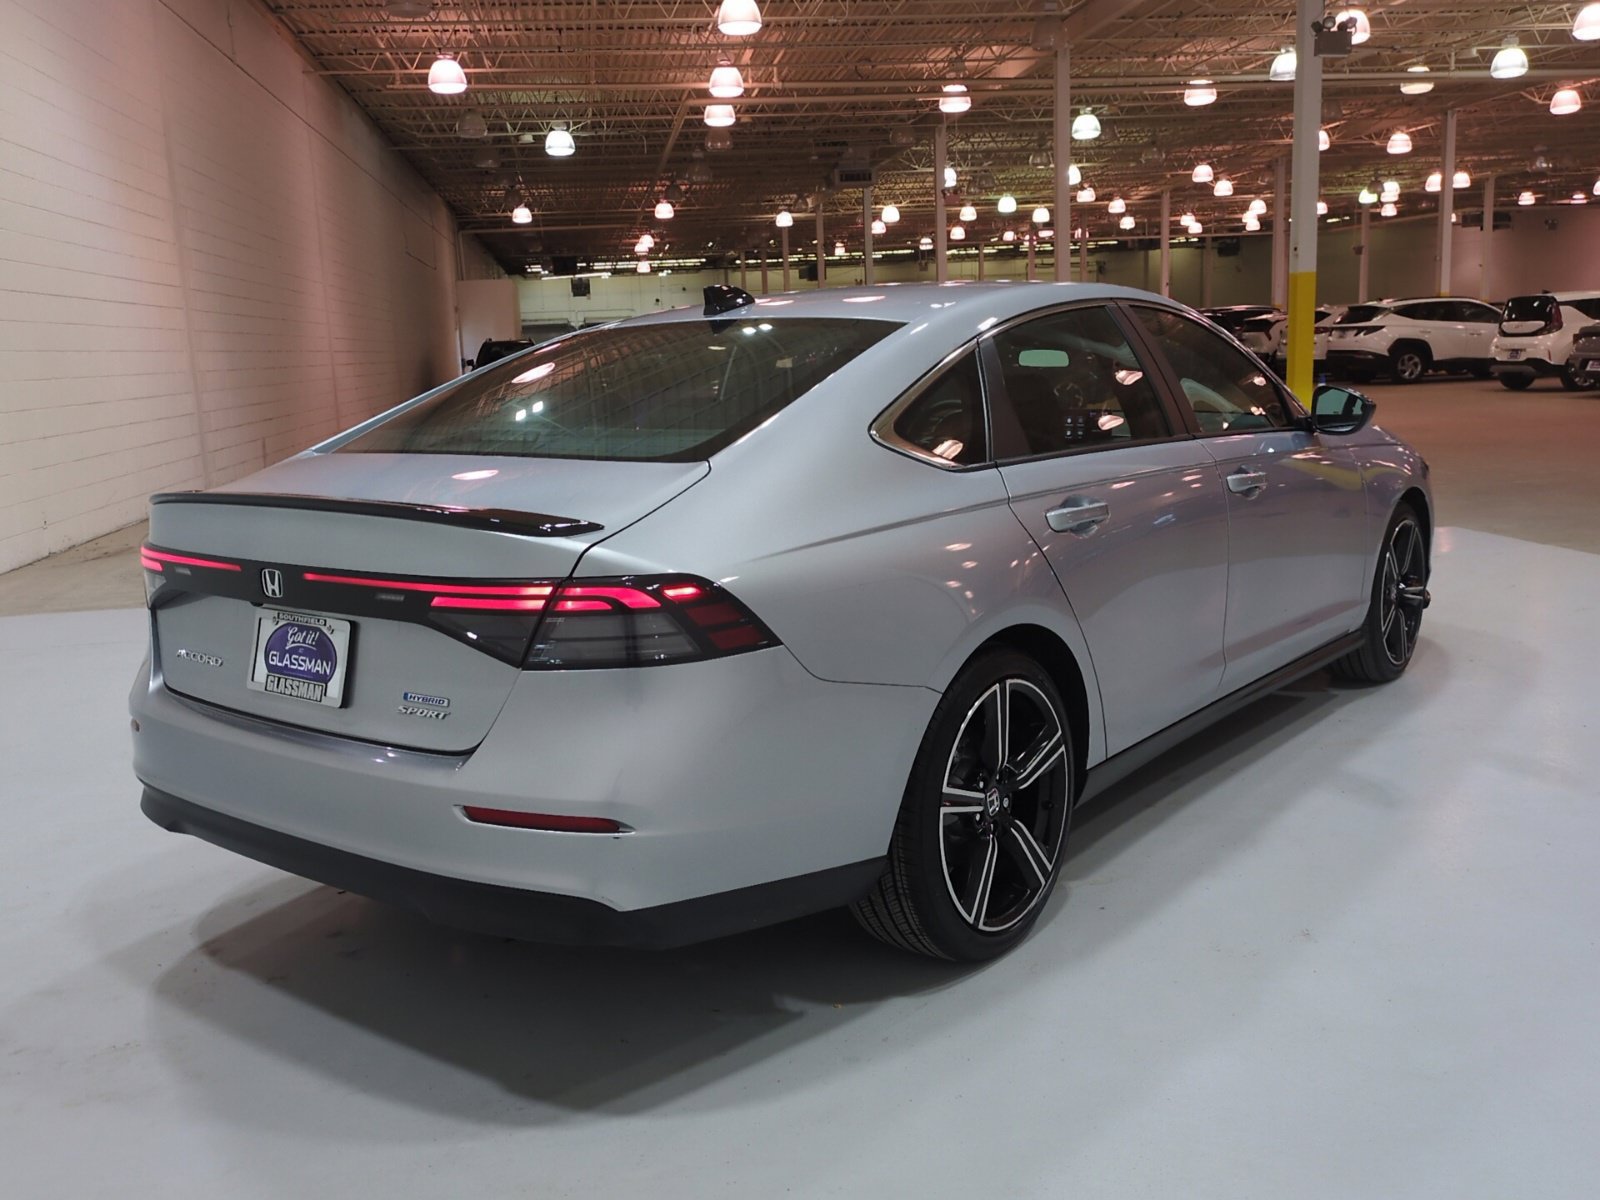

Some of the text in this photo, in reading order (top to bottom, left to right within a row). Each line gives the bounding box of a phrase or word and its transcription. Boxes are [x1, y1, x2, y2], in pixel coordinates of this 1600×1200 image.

[279, 613, 325, 626] SOUTHFIELD
[287, 627, 320, 646] Got it!
[176, 649, 222, 667] ACCORD
[269, 651, 331, 675] GLASSMAN
[266, 676, 322, 701] GLASSMAN
[409, 694, 446, 705] HYBRID
[397, 705, 451, 720] SPORT
